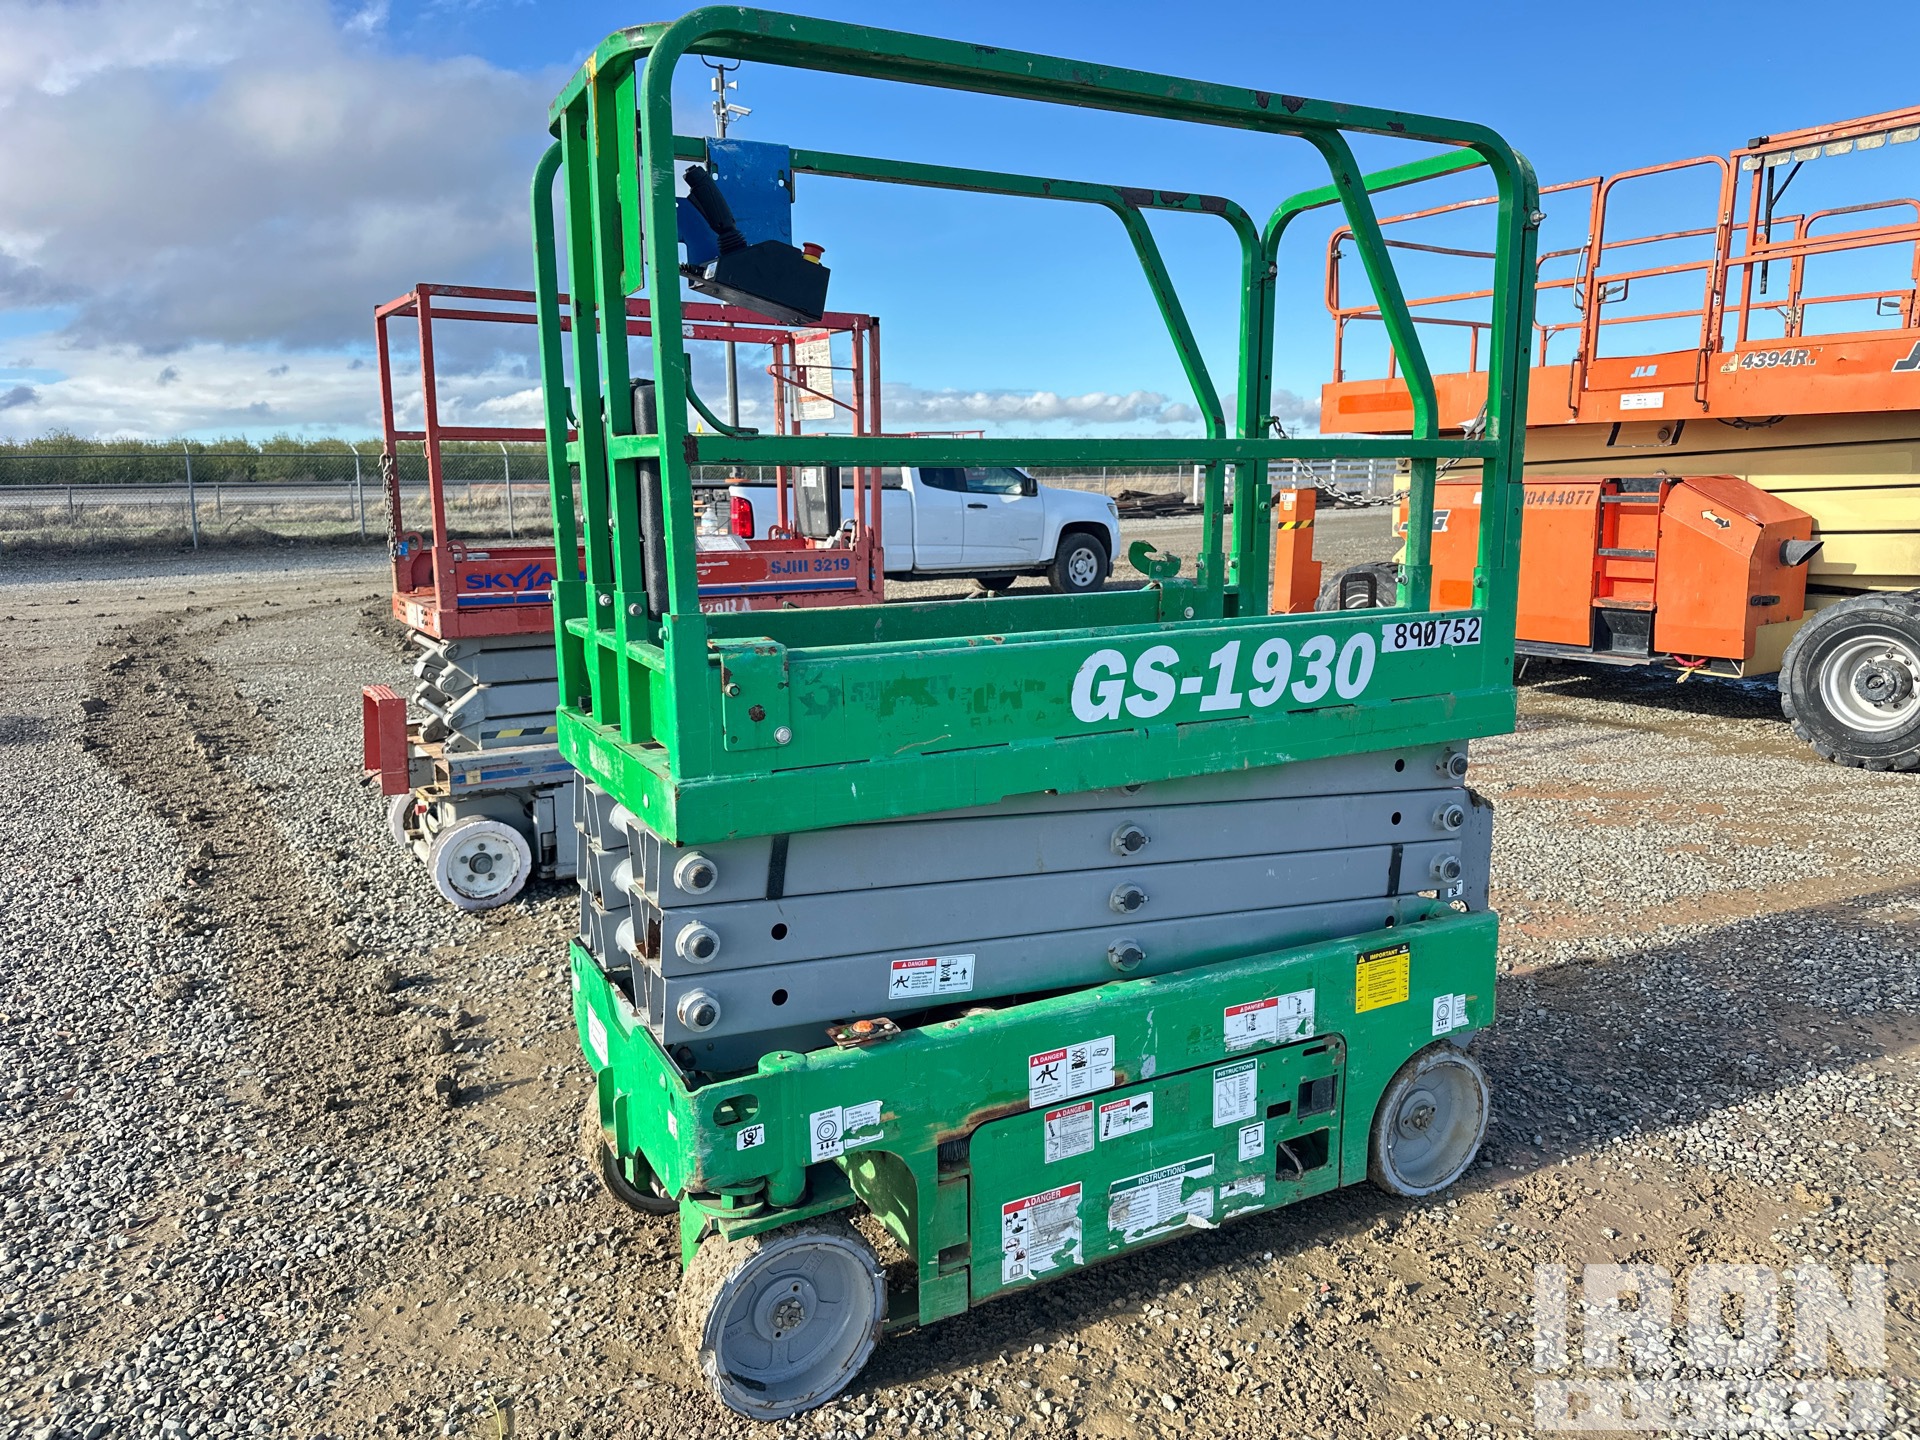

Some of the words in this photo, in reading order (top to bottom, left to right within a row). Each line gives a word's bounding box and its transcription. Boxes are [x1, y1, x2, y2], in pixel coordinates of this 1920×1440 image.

[814, 557, 850, 572] 3219
[465, 563, 587, 591] SKYJA
[1394, 617, 1481, 649] 890752
[1070, 632, 1376, 723] GS-1930
[1369, 949, 1399, 960] IMPORTANT
[907, 960, 928, 968] DANGER
[1243, 1002, 1265, 1012] DANGER
[1039, 1052, 1064, 1062] DANGER
[1217, 1062, 1254, 1077] INSTRUCTIONS
[1062, 1104, 1086, 1117] DANGER
[1108, 1101, 1127, 1111] DANGER
[1138, 1164, 1186, 1185] INSTRUCTIONS
[1030, 1190, 1061, 1206] DANGER
